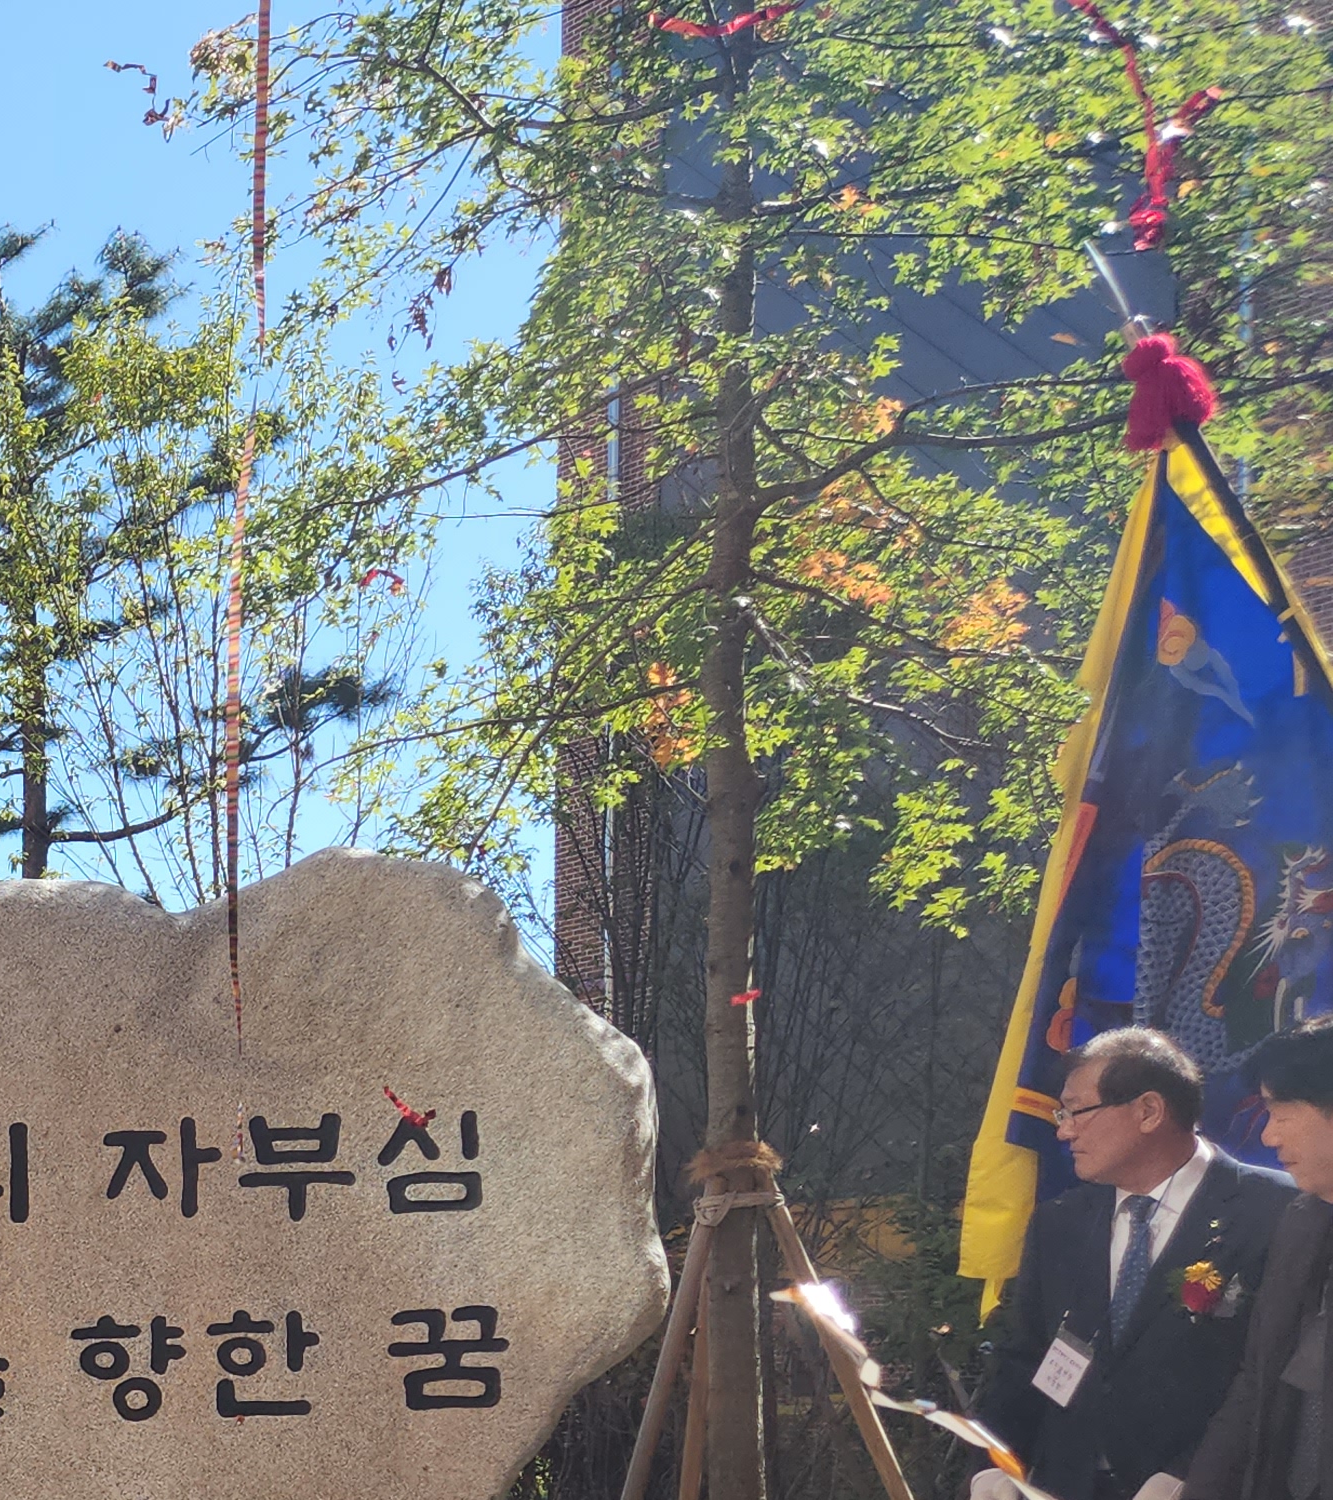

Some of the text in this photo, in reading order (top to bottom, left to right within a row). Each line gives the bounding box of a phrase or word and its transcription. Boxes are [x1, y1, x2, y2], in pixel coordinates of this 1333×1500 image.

[103, 1110, 481, 1221] 자부심
[70, 1311, 320, 1422] 향한
[388, 1305, 509, 1411] 꿈
